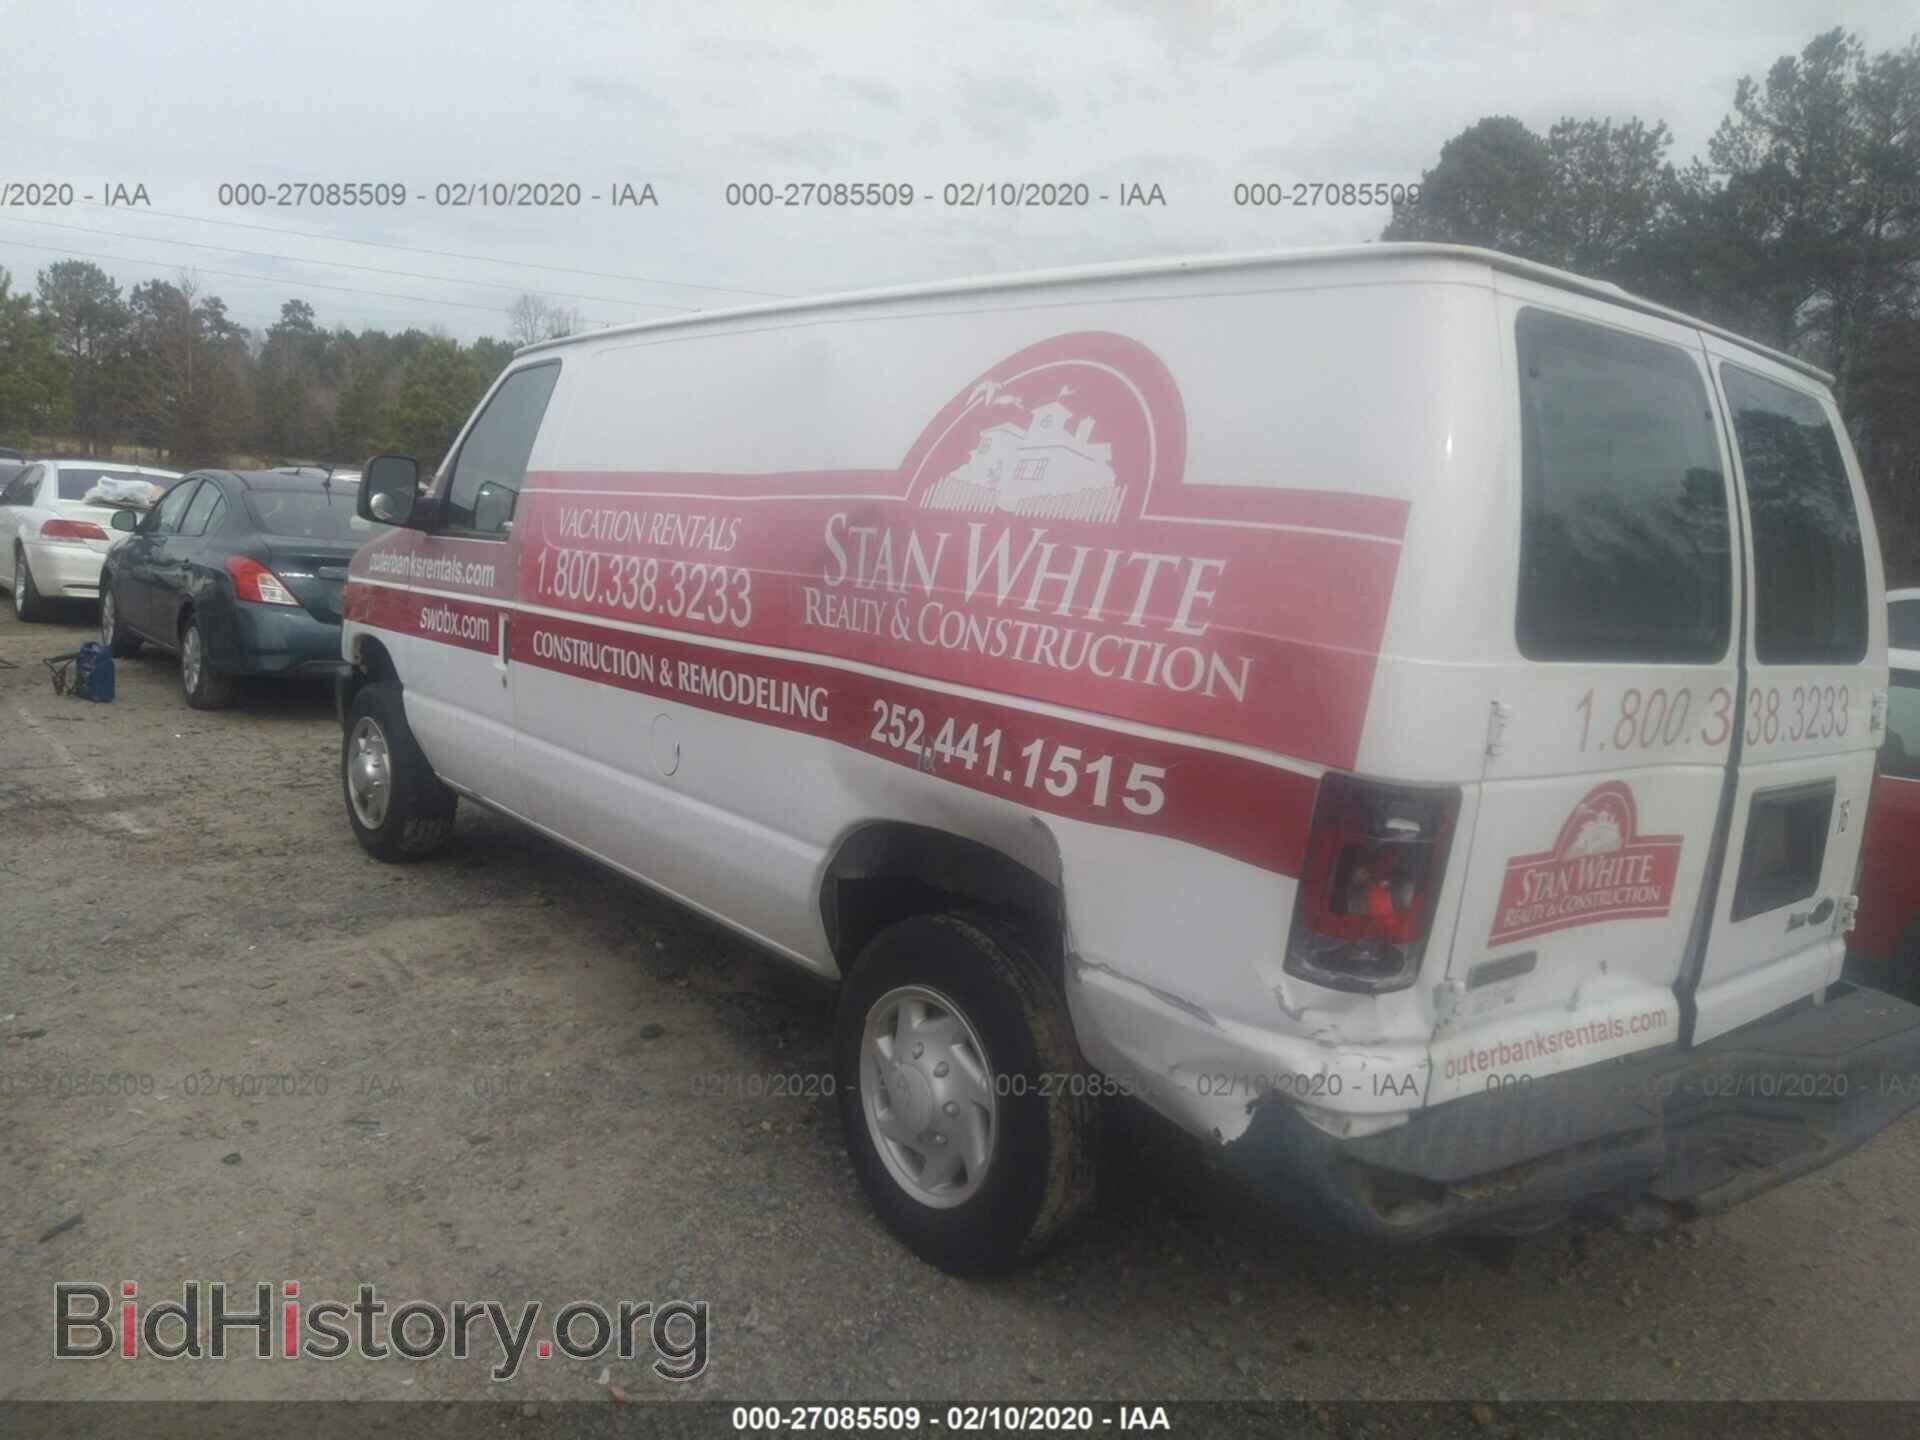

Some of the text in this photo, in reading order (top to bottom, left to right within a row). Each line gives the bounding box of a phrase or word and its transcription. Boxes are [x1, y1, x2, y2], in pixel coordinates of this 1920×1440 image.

[559, 506, 743, 553] VACATION RENTALS
[369, 548, 497, 588] outerbanksrentals.com
[536, 546, 753, 629] 1.800.338.3233
[822, 512, 1227, 637] STAN WHITE
[420, 604, 489, 642] swobx.com
[802, 586, 1255, 703] REALTY & CONSTRUCTION
[532, 629, 829, 723] CONSTRUCTION & REMODELING
[1576, 685, 1850, 752] 1.800.338.3233
[870, 699, 1168, 817] 252.441.1515
[1516, 854, 1654, 907] STAN WHITE
[1443, 1006, 1669, 1080] outerbanksrentals.com
